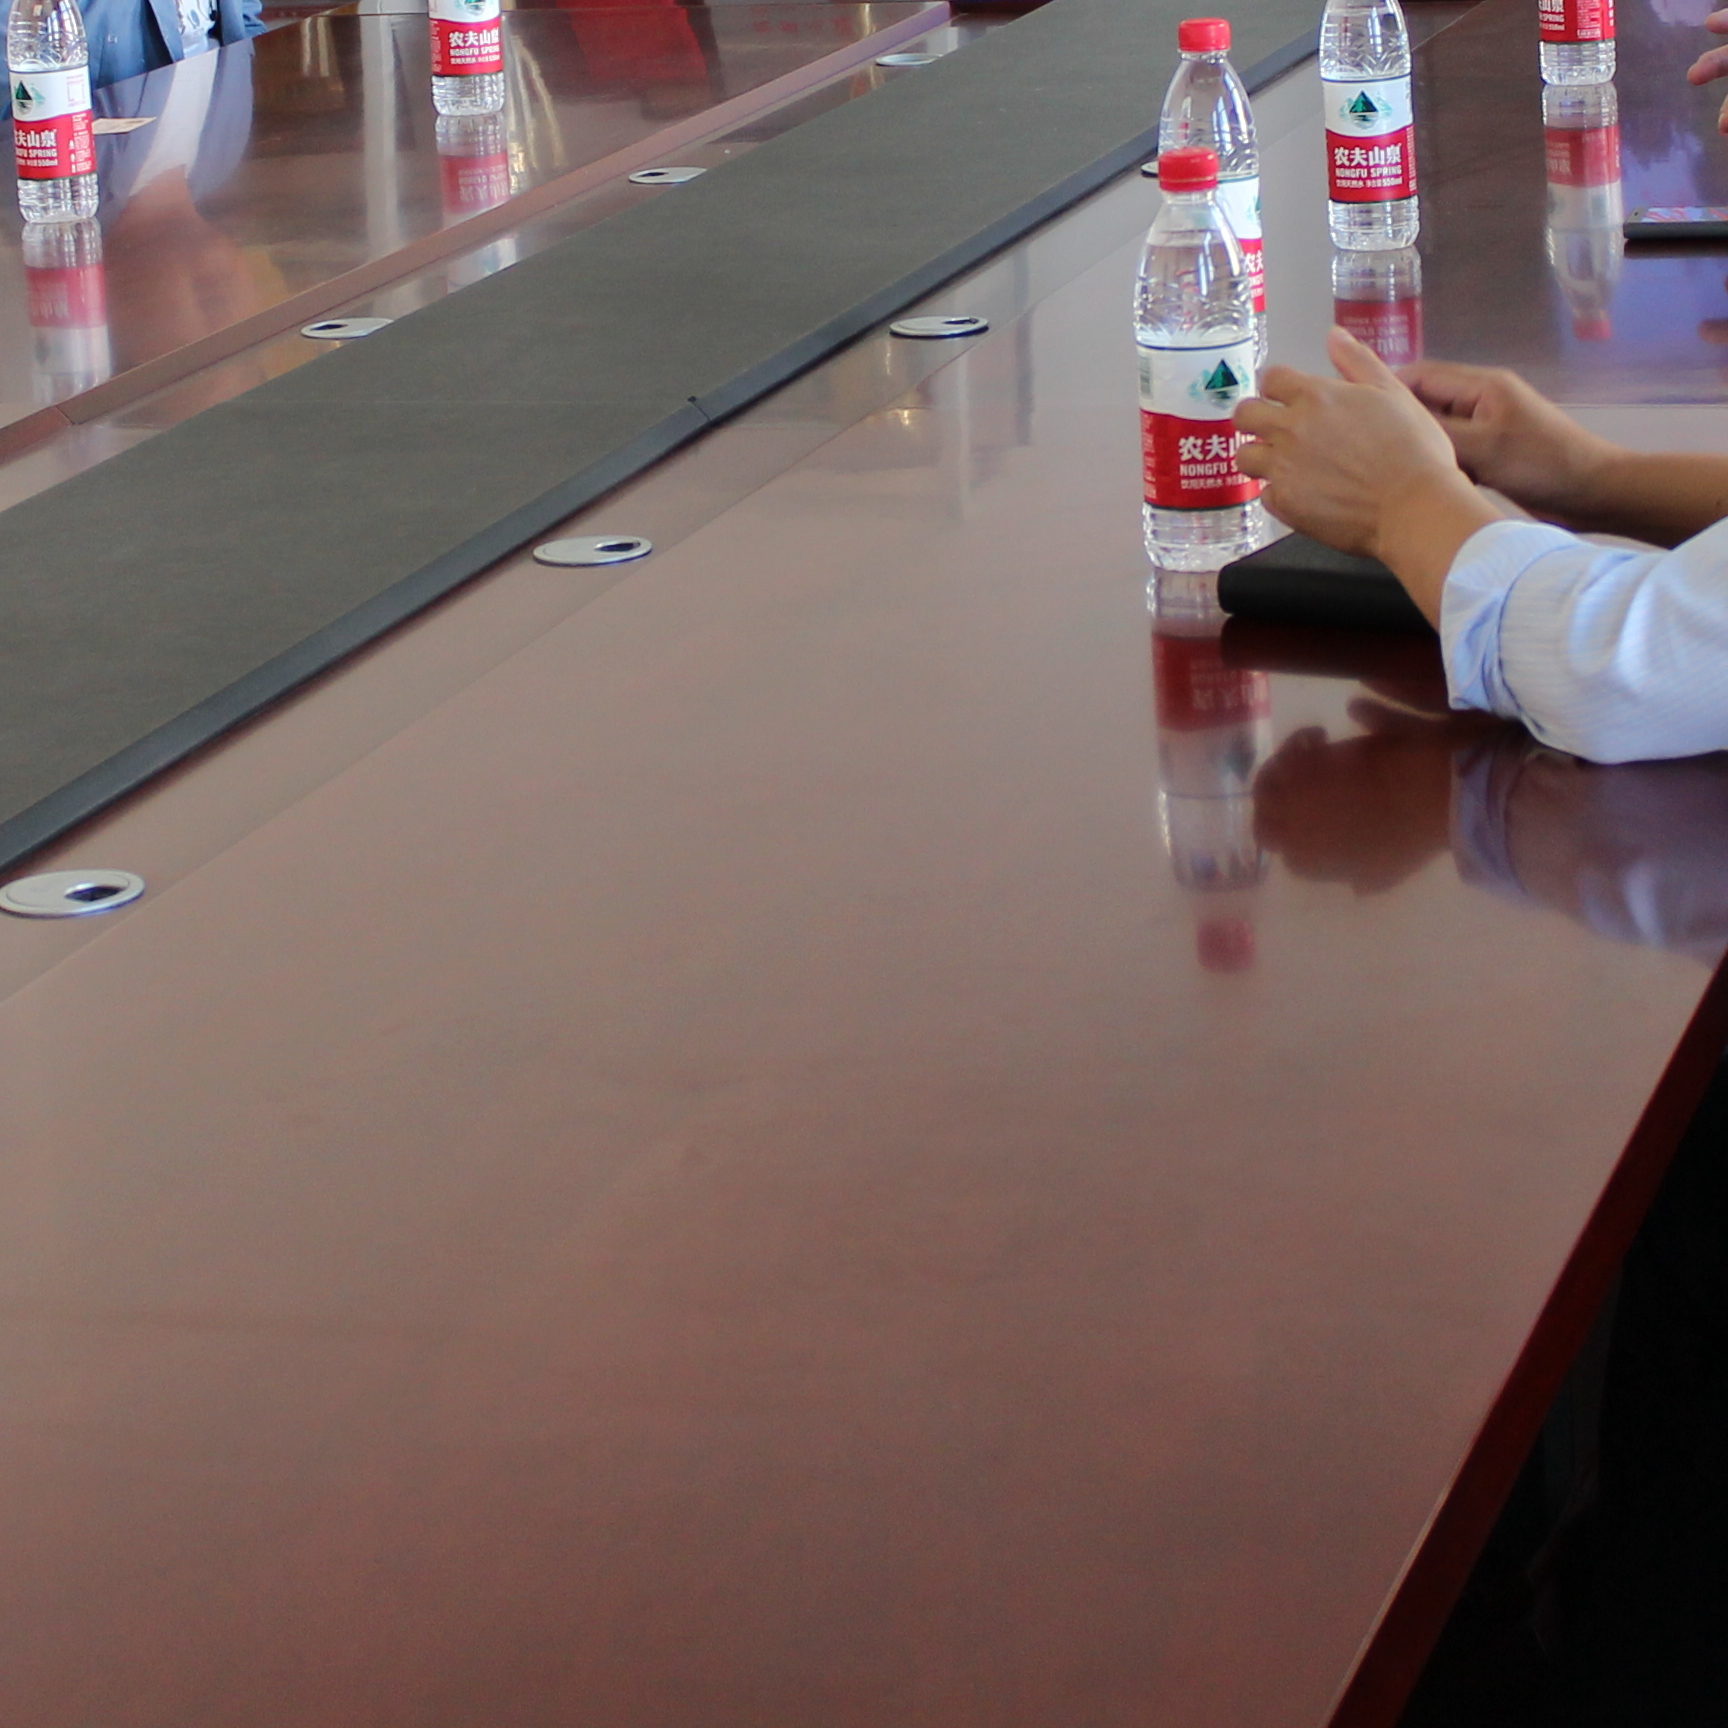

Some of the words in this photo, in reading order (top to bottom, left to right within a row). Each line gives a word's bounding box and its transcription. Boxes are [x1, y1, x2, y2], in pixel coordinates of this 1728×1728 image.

[1334, 143, 1402, 167] 农夫山泉
[1370, 165, 1402, 178] SPRING
[1180, 462, 1228, 477] NONGFU
